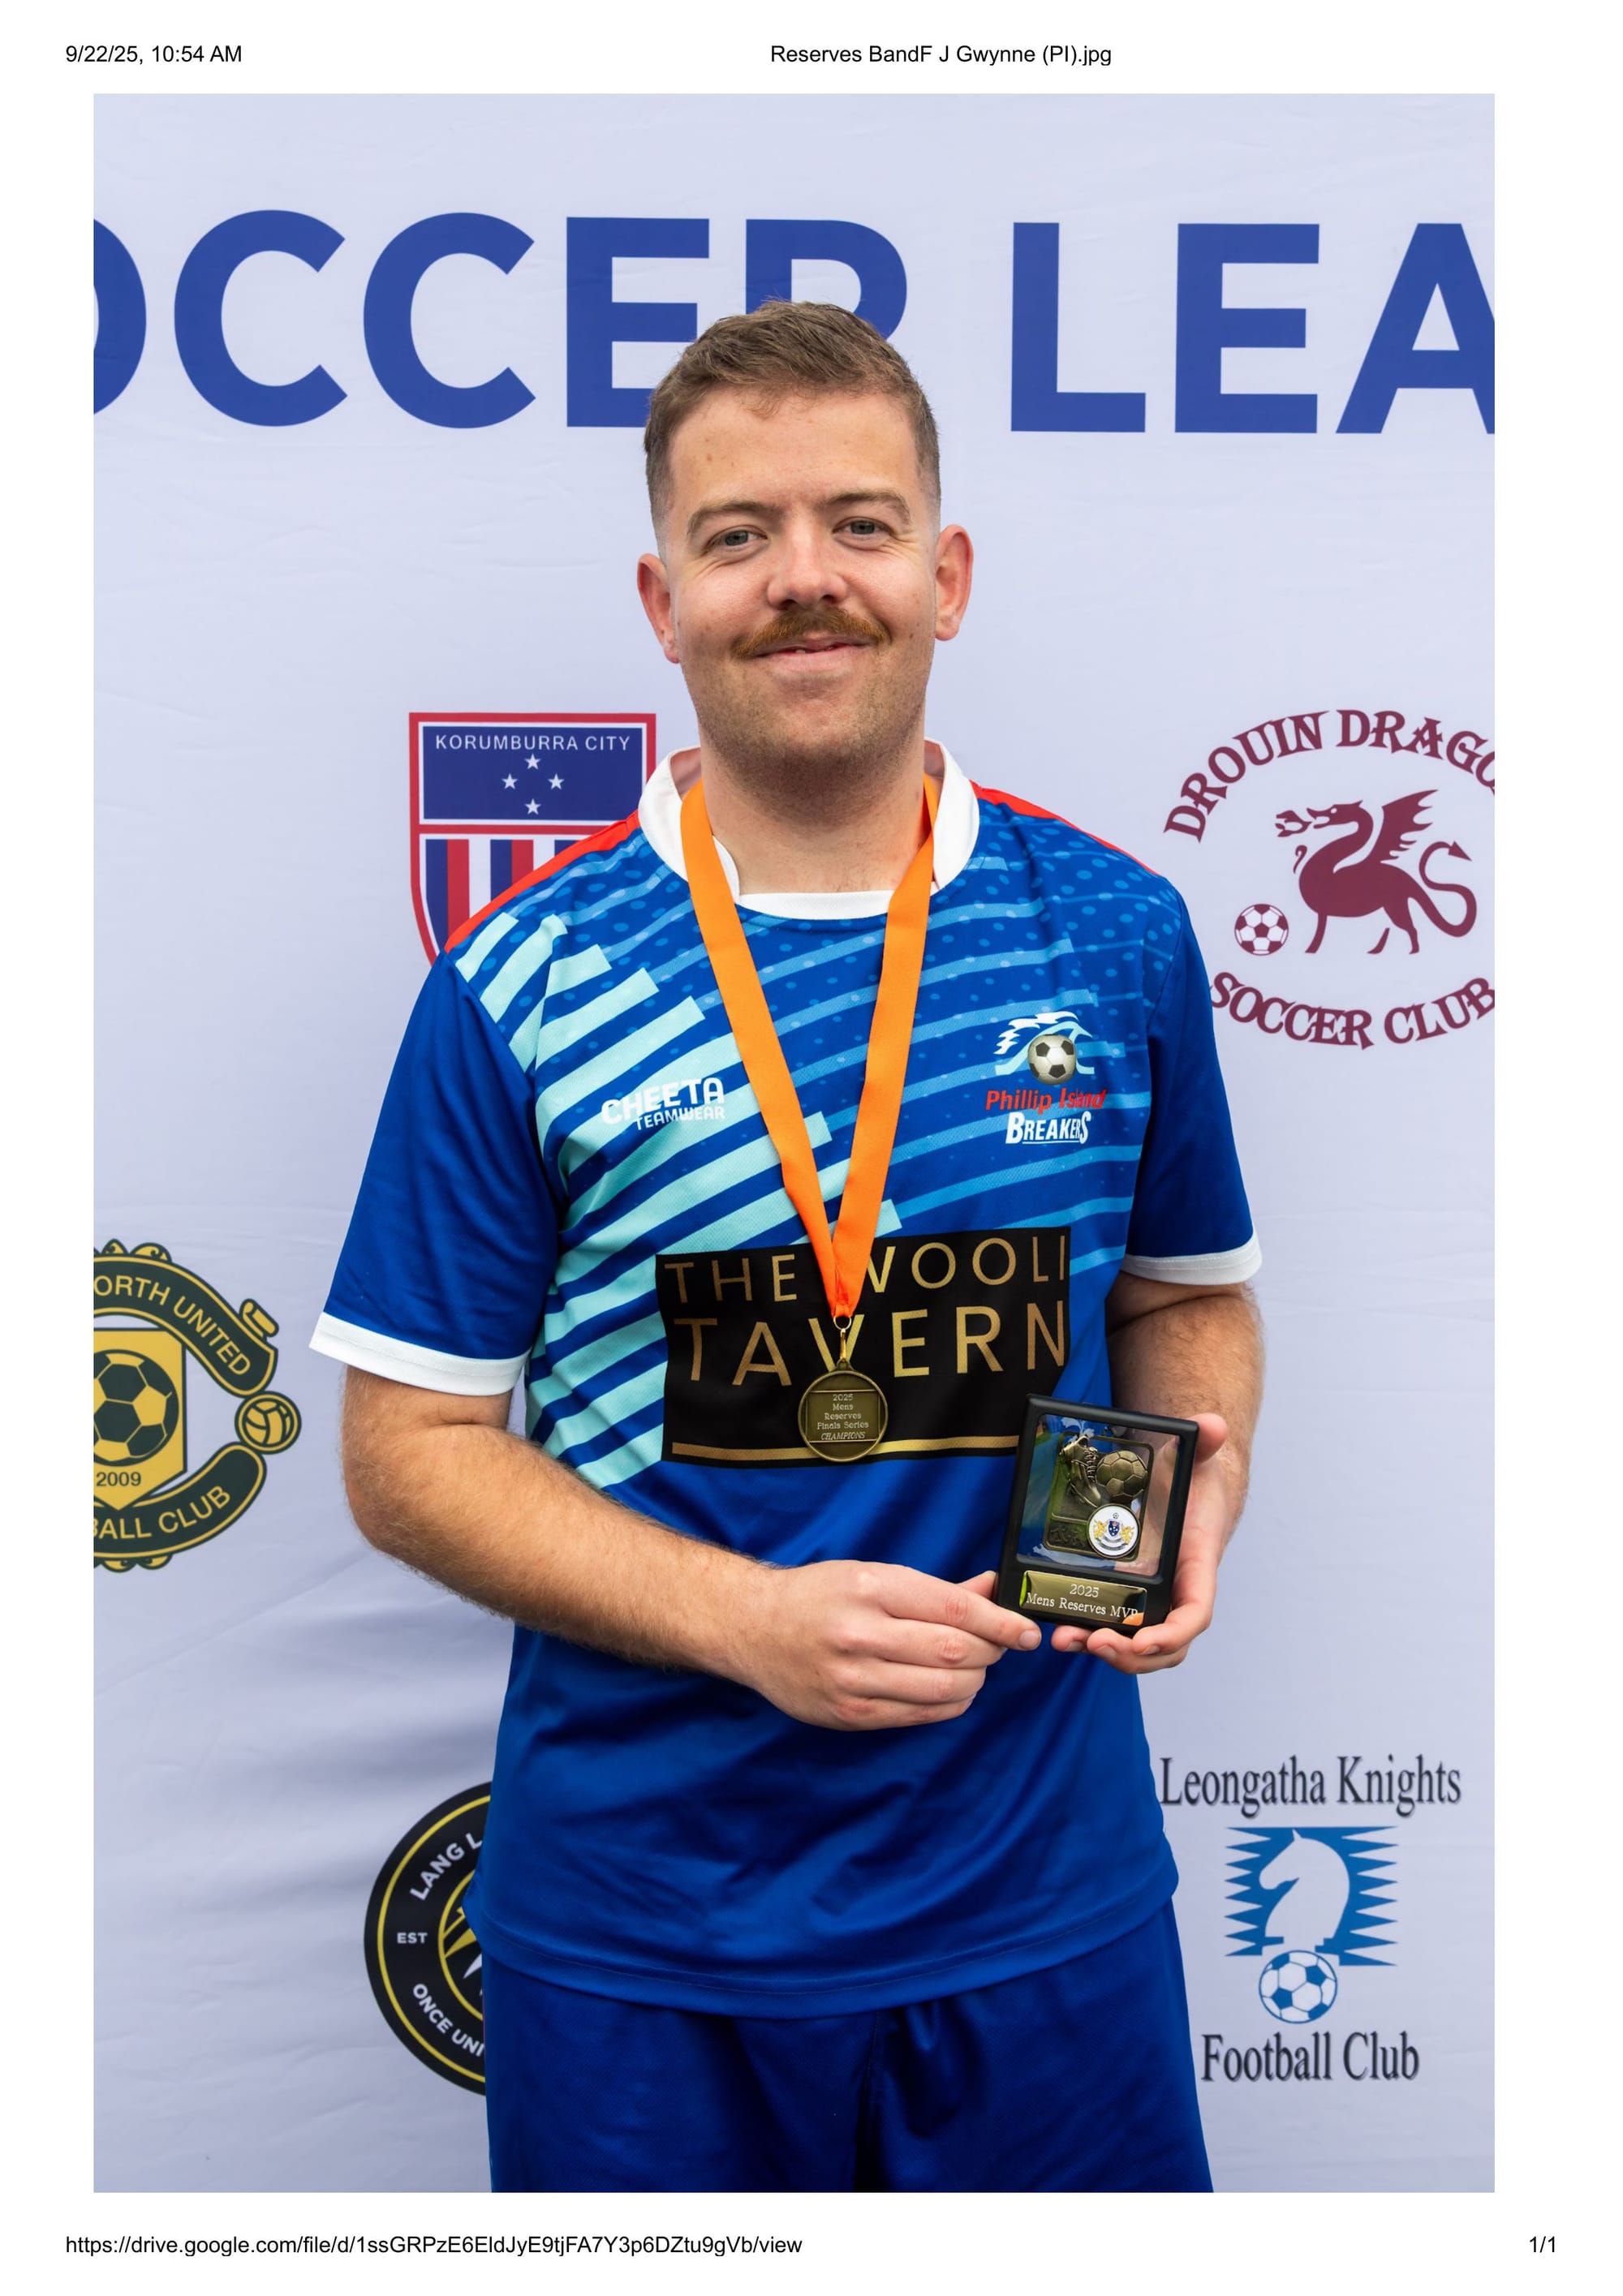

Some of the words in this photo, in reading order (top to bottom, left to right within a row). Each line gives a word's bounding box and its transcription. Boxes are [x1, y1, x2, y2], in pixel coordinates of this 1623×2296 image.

[93, 209, 906, 428] CCER
[1011, 222, 1495, 434] LEA
[436, 734, 579, 750] KORUMBURRA
[585, 736, 631, 751] CITY
[1163, 710, 1330, 843] DROUIN
[1210, 972, 1375, 1051] SOCCER
[1384, 978, 1495, 1043] CLUB
[601, 1077, 725, 1124] CHEETA
[635, 1105, 725, 1131] TEAMWEAR
[986, 1089, 1053, 1115] Phillip
[1058, 1086, 1109, 1110] Isand
[1005, 1111, 1091, 1145] BREAKERS
[665, 1253, 798, 1304] THE
[93, 1275, 170, 1305] ORTH
[173, 1296, 251, 1376] UNITED
[674, 1300, 1065, 1387] TAVERN
[824, 1412, 862, 1421] Reserves
[833, 1394, 854, 1402] 2025
[817, 1422, 841, 1430] Finals
[844, 1421, 869, 1429] Series
[820, 1431, 866, 1441] CHAMPIONS
[96, 1471, 142, 1487] 2009
[158, 1485, 231, 1534] CLUB
[1026, 1592, 1055, 1609] Mens
[1058, 1598, 1107, 1615] Reserves
[1070, 1584, 1100, 1598] 2025
[1160, 1755, 1326, 1819] Leongatha
[1336, 1753, 1462, 1818] Knights
[410, 1842, 465, 1902] LANG
[397, 1933, 428, 1944] EST
[413, 1984, 454, 2034] ONCE
[1201, 2032, 1332, 2082] Football
[1343, 2030, 1420, 2081] Club
